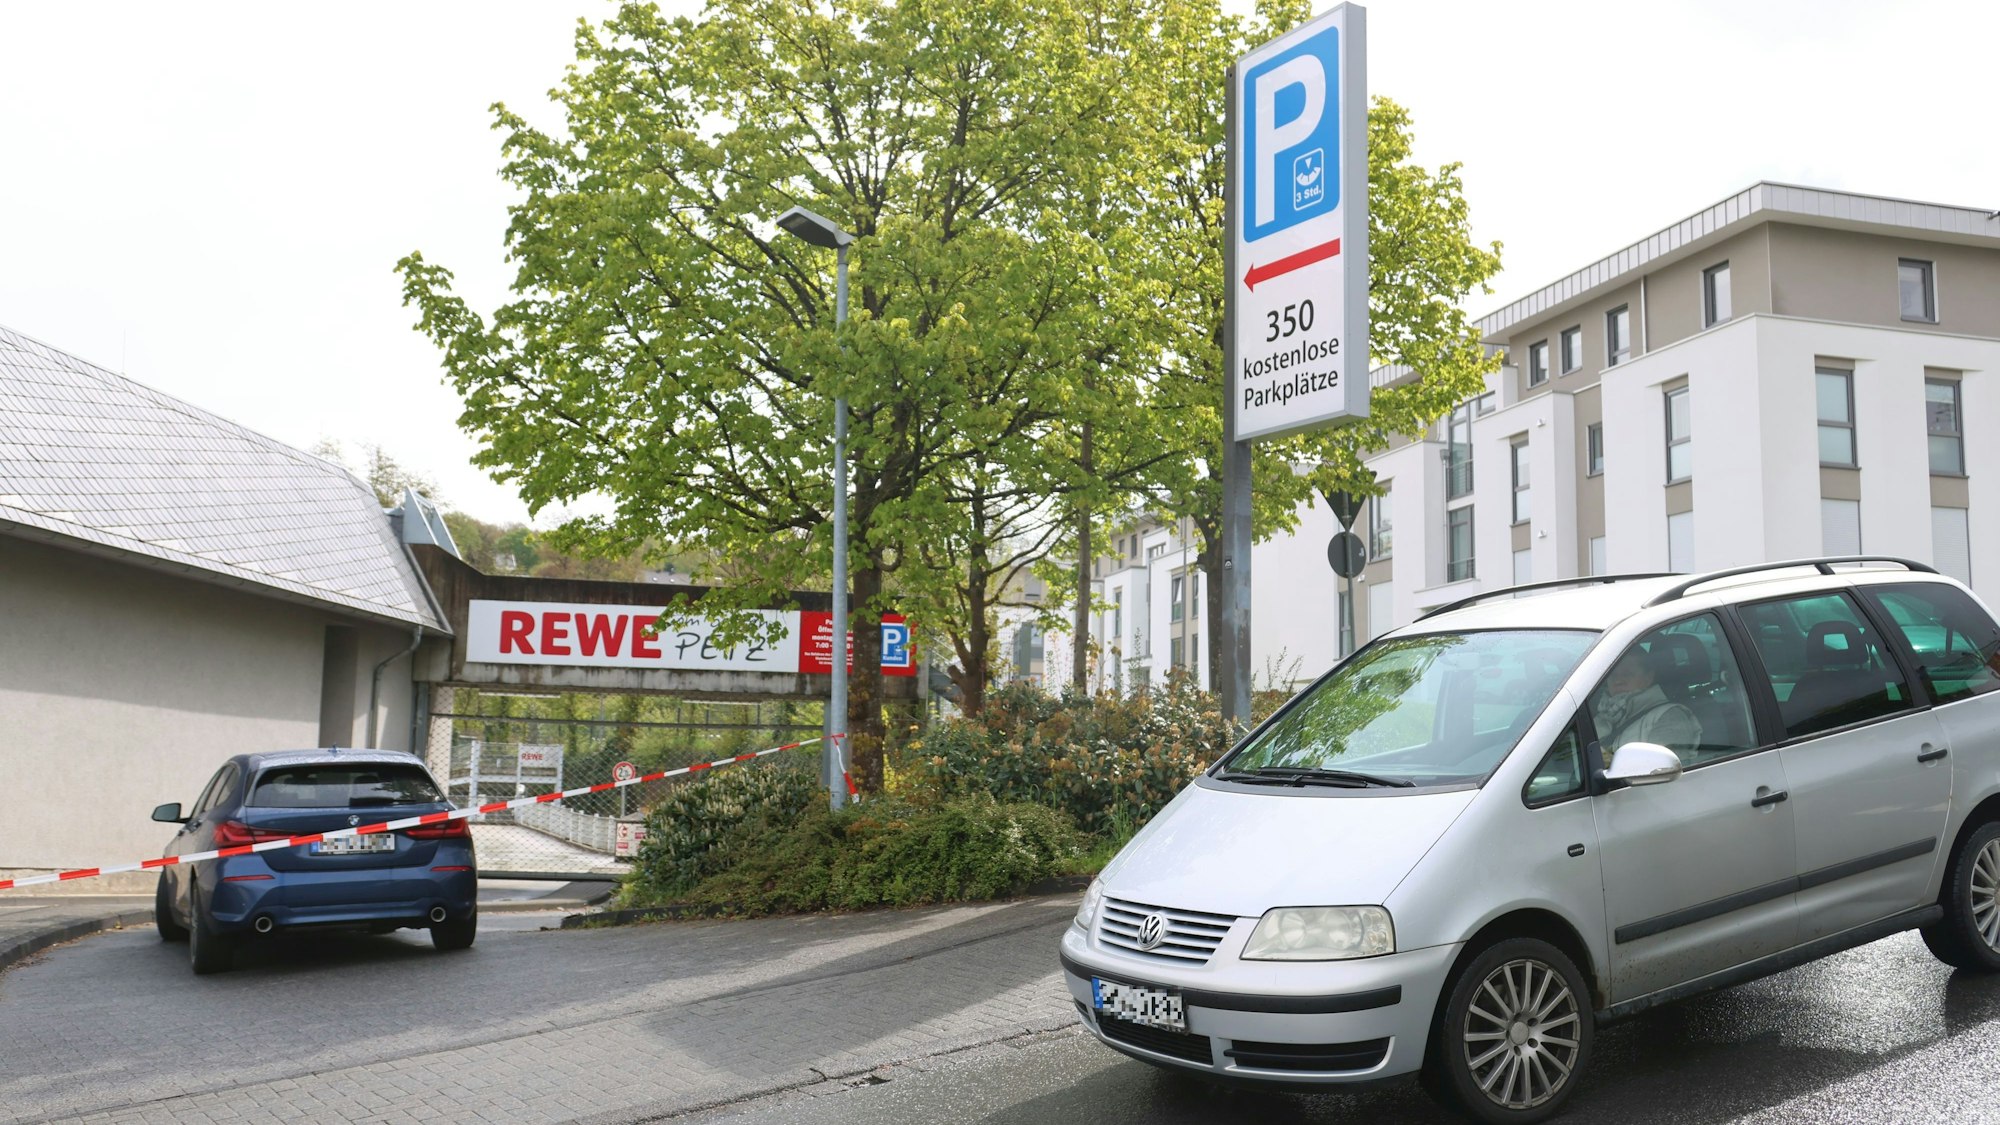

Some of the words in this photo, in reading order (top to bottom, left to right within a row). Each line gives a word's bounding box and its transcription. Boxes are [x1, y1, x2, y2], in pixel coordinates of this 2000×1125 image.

[1255, 54, 1326, 228] P
[1296, 192, 1302, 203] 3
[1304, 185, 1321, 200] Std.
[1266, 299, 1314, 342] 350
[1244, 338, 1339, 380] kostenlose
[1244, 370, 1338, 410] Parkplätze
[499, 610, 662, 658] REWE
[882, 628, 902, 655] P
[521, 753, 543, 761] REWE
